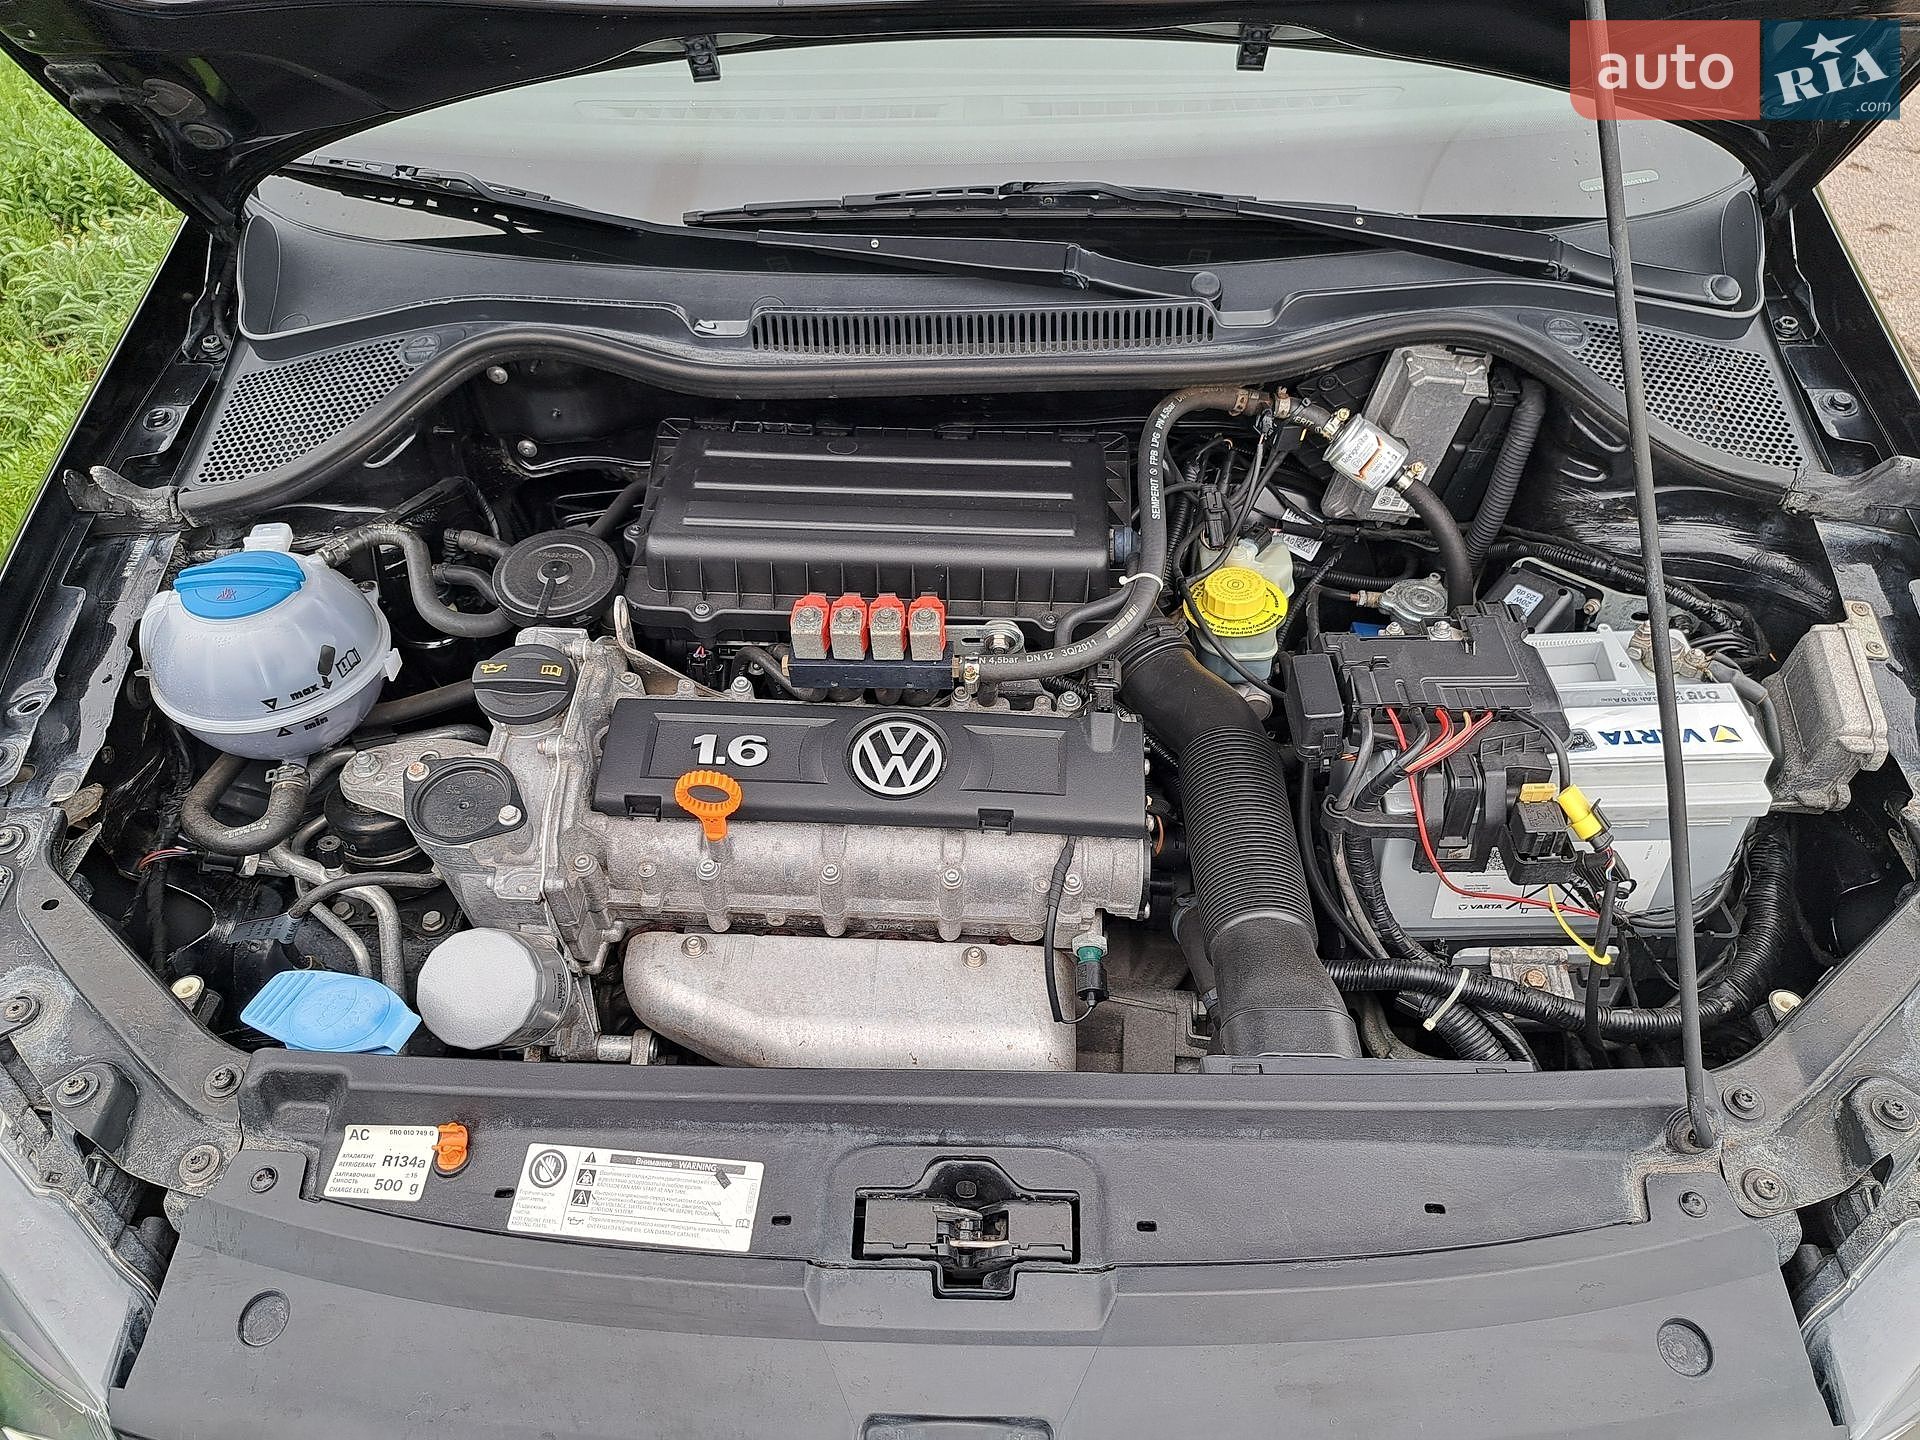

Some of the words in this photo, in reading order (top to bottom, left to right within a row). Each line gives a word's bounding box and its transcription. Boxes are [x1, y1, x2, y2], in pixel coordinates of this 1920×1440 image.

[1152, 432, 1161, 448] LPG
[1149, 449, 1159, 466] FPB
[1149, 478, 1160, 520] SEMPERIT
[988, 656, 1019, 665] 4,5bar
[1026, 654, 1041, 663] DN
[1043, 652, 1055, 661] 12
[1061, 639, 1098, 658] 3Q/2011
[290, 683, 320, 701] max
[1685, 690, 1720, 700] D15
[304, 716, 329, 731] min
[1598, 728, 1707, 745] VRTA
[693, 734, 769, 767] 1.6
[851, 721, 943, 796] VW
[1469, 903, 1503, 911] VARTA
[349, 1128, 370, 1141] AC
[382, 1154, 426, 1169] R134a
[636, 1157, 673, 1168] Внимание
[679, 1160, 718, 1172] WARNING
[374, 1178, 403, 1192] 500
[409, 1183, 419, 1195] g
